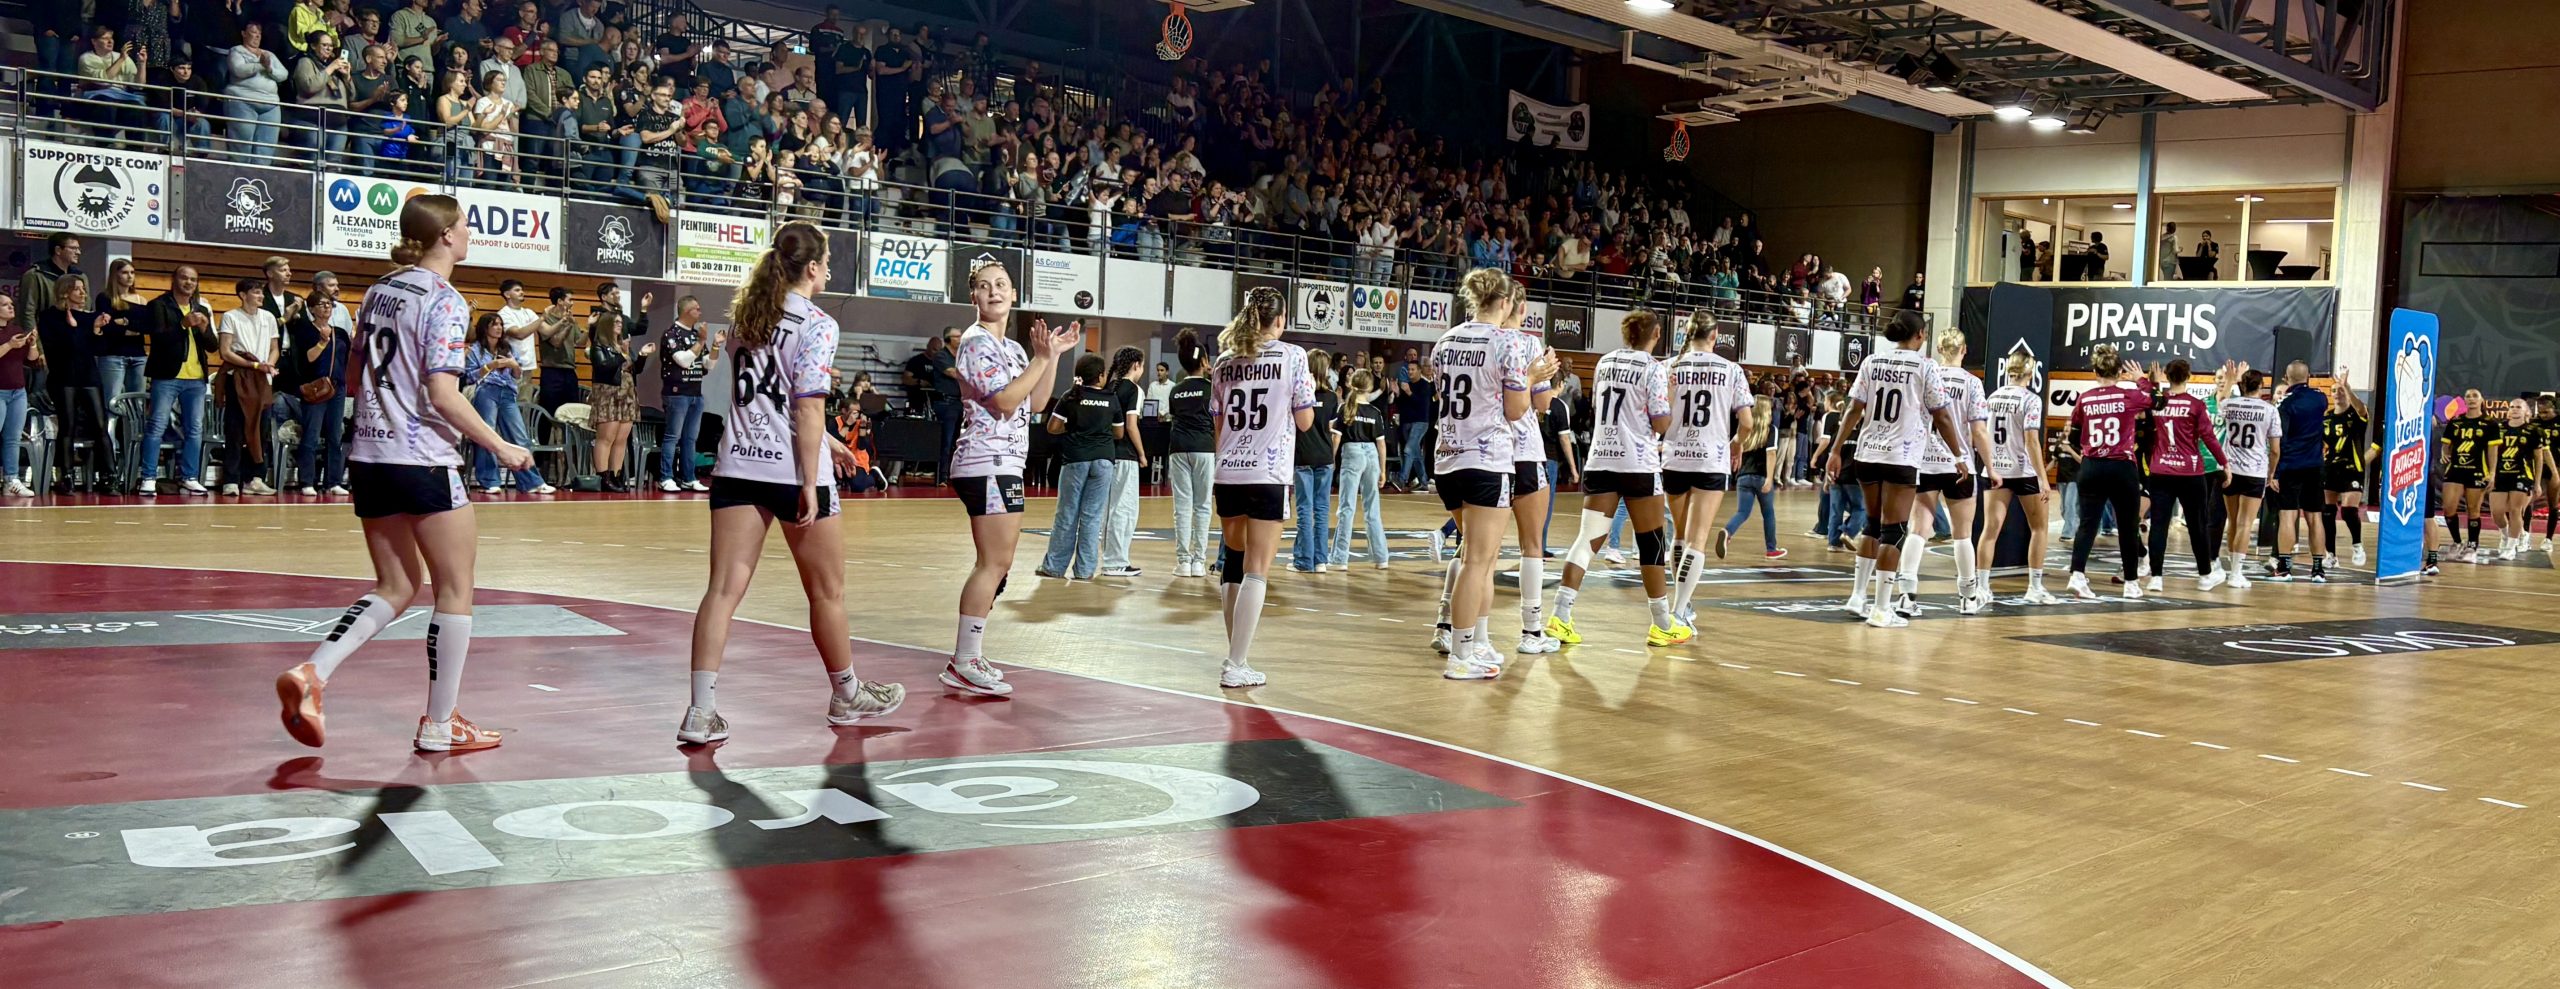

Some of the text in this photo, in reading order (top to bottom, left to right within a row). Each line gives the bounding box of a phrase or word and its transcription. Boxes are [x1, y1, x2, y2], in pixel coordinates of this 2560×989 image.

[29, 148, 100, 165] SUPPORTS
[105, 155, 122, 168] DE
[225, 214, 274, 233] PIRATHS
[333, 215, 398, 231] ALEXANDRE
[337, 226, 373, 235] STRASBOURG
[468, 204, 550, 239] ADEX
[681, 219, 717, 234] PEINTURE
[718, 224, 765, 246] HELM
[347, 239, 387, 250] 03 88 33
[511, 242, 550, 252] LOGISTIQUE
[880, 238, 938, 260] POLY
[597, 247, 634, 264] PIRATHS
[1036, 257, 1045, 265] AS
[690, 261, 742, 273] 06 30 28 77 81
[874, 258, 933, 281] RACK
[1354, 310, 1396, 320] ALEXANDRE PETRI
[1409, 300, 1448, 322] ADEX
[1554, 318, 1581, 335] PIRATHS
[2065, 302, 2218, 350] PIRATHS
[2080, 340, 2197, 360] HNDBALL
[734, 346, 787, 415] 64
[1220, 363, 1282, 384] FRACHON
[1174, 390, 1204, 399] OCÉANE
[1439, 372, 1473, 421] 33
[1227, 388, 1269, 431] 35
[1601, 386, 1627, 426] 17
[1680, 389, 1712, 428] 13
[1873, 386, 1903, 424] 10
[2083, 401, 2126, 417] FARGUES
[1994, 416, 2008, 446] 5
[2088, 416, 2121, 449] 53
[2164, 419, 2176, 447] 1
[2228, 422, 2257, 449] 26
[2335, 424, 2343, 436] 5
[2397, 416, 2422, 444] LIGUE
[2461, 428, 2474, 439] 14
[1863, 441, 1893, 452] Politec
[2505, 435, 2518, 447] 17
[730, 444, 784, 461] Politec
[1593, 449, 1627, 457] Politec
[1674, 449, 1709, 459] Politec
[1221, 458, 1258, 468] Politec
[2159, 458, 2187, 467] Politec
